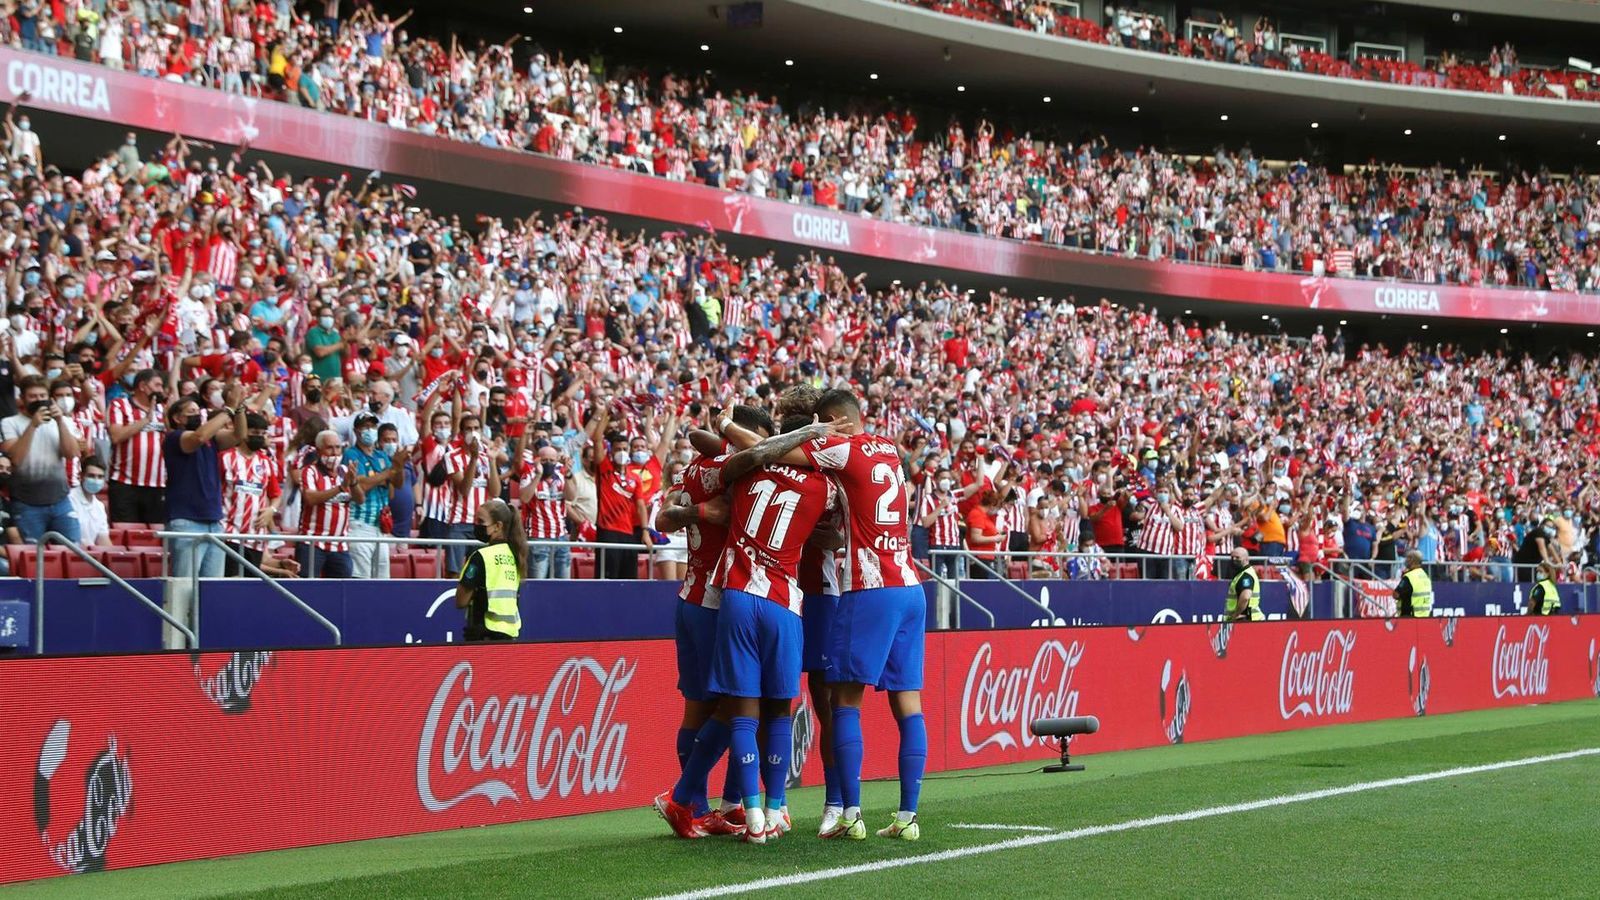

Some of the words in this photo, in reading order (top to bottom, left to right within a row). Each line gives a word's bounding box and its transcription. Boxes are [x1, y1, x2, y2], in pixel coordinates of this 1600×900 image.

[7, 60, 111, 112] CORREA
[793, 212, 851, 246] CORREA
[1375, 287, 1440, 312] CORREA
[744, 479, 802, 551] 11
[874, 531, 897, 550] ria
[960, 639, 1085, 754] Coca-Cola
[1279, 629, 1357, 720] Coca-Cola
[1492, 623, 1549, 699] Coca-Cola
[416, 656, 639, 812] Coca-Cola
